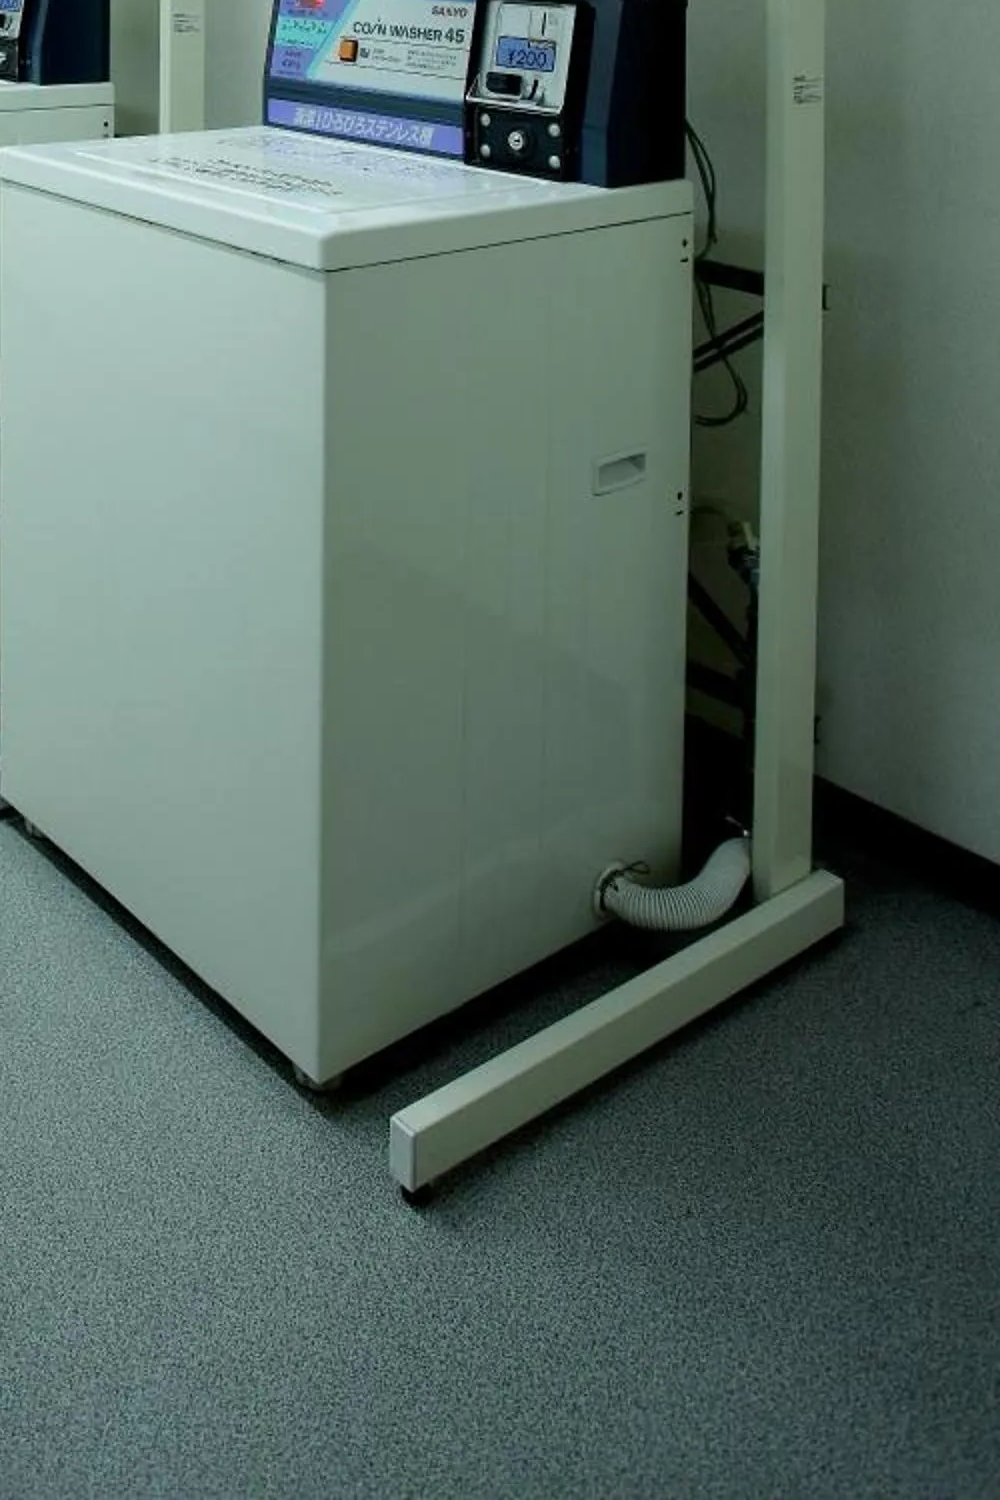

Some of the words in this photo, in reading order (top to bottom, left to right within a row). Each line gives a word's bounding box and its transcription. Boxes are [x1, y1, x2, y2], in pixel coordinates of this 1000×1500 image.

[432, 5, 468, 18] SANYO
[390, 25, 442, 42] WASHER
[445, 27, 465, 44] 45
